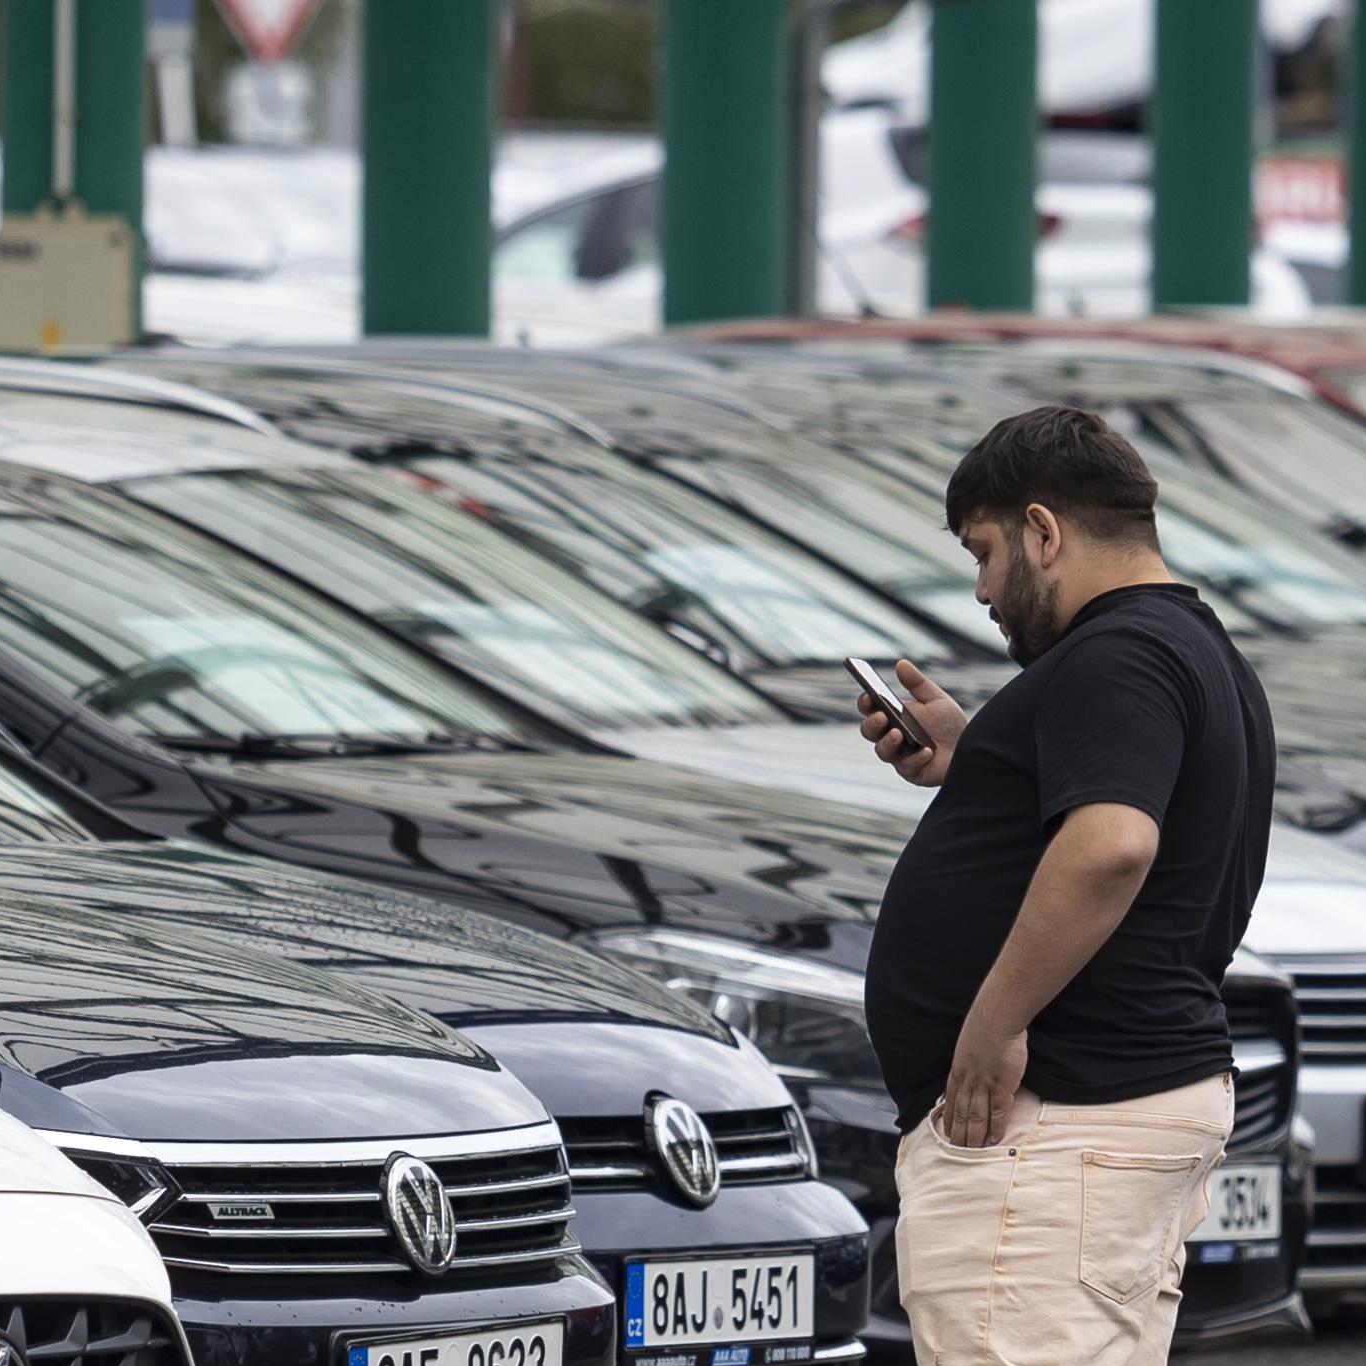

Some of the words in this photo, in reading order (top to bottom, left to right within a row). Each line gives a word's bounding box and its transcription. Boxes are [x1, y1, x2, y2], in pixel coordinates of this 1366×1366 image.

[217, 1206, 267, 1217] ALLTRACK
[627, 1318, 643, 1337] CZ
[653, 1270, 708, 1336] 8AJ
[731, 1265, 799, 1332] 5451
